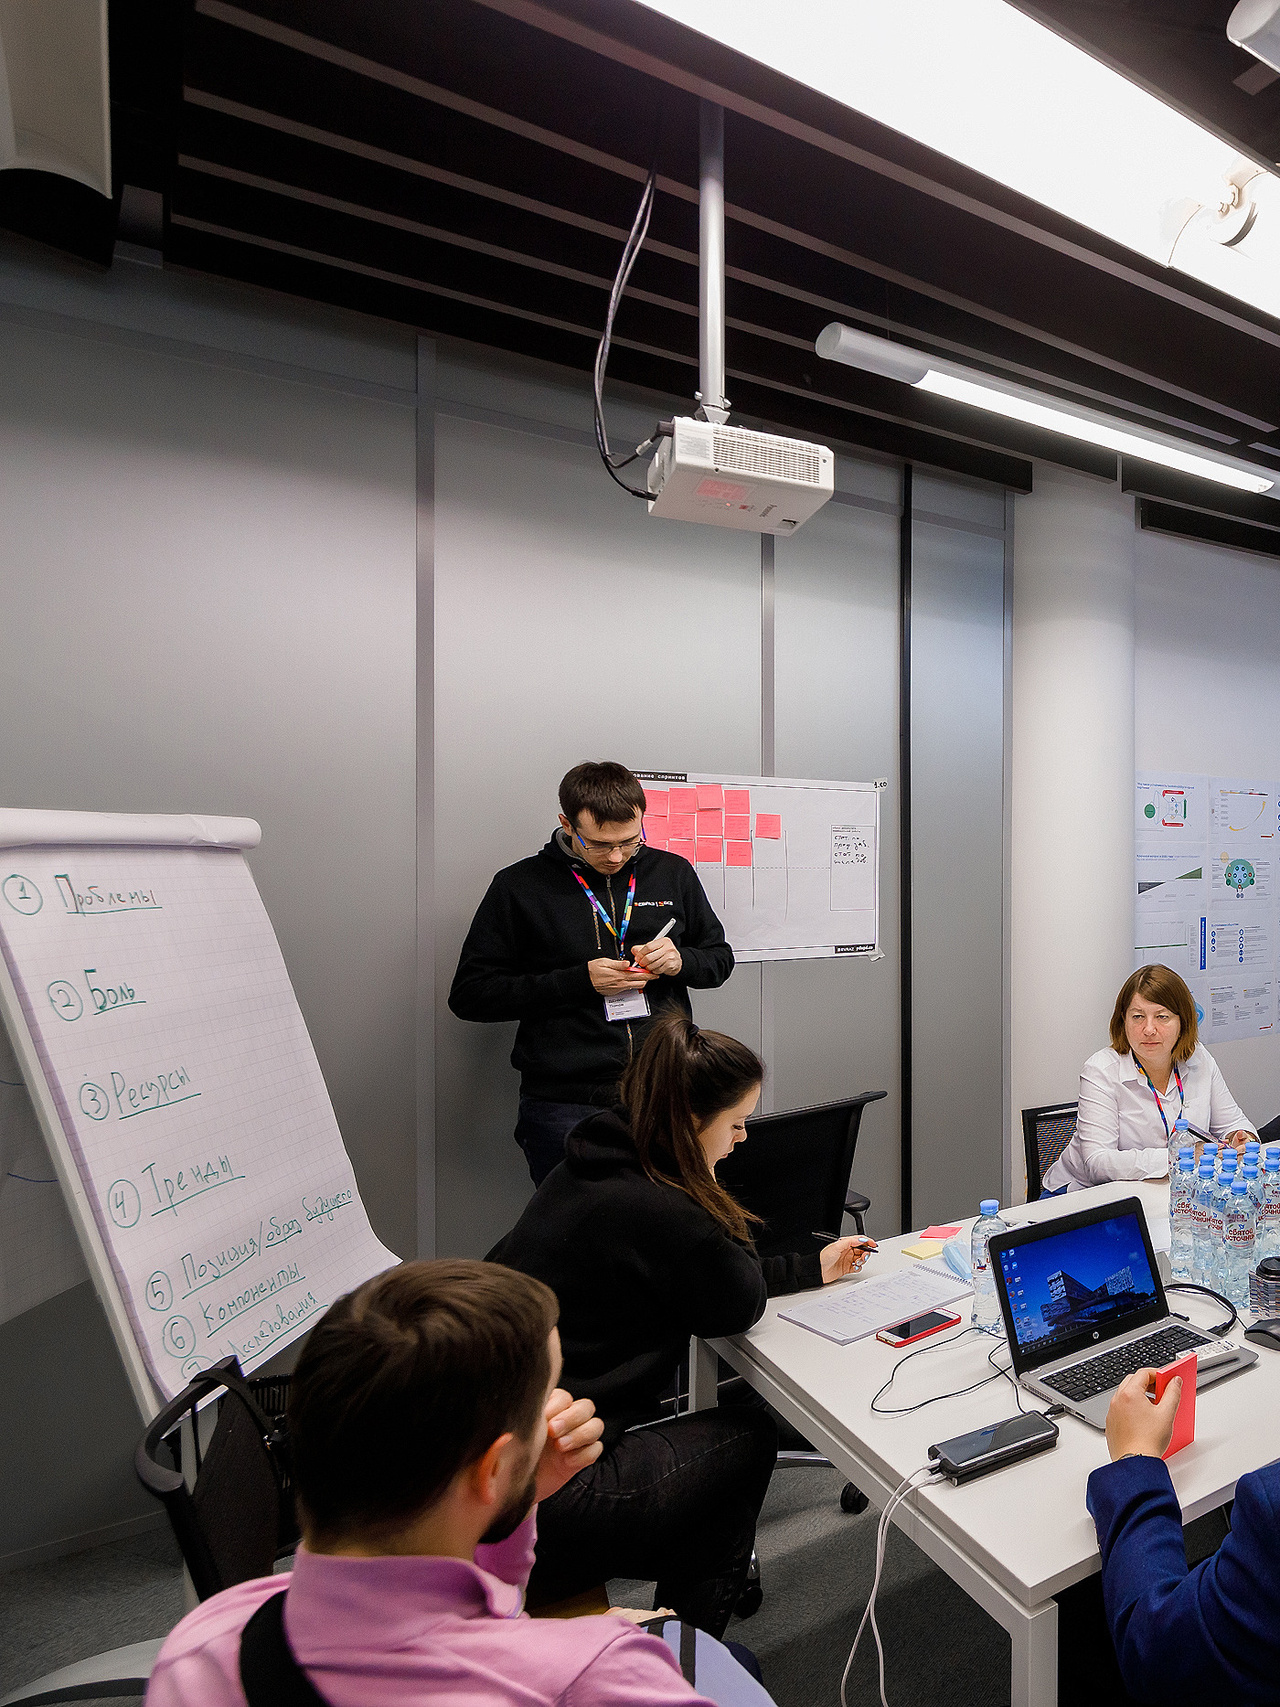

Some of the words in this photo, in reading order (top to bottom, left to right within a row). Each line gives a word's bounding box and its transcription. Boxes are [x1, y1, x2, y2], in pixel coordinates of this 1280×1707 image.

[54, 873, 157, 917] Проблемы
[84, 968, 135, 1011] Боль
[111, 1066, 191, 1114] Ресурсы
[141, 1155, 234, 1217] Тренды
[199, 1262, 300, 1332] Компоненты
